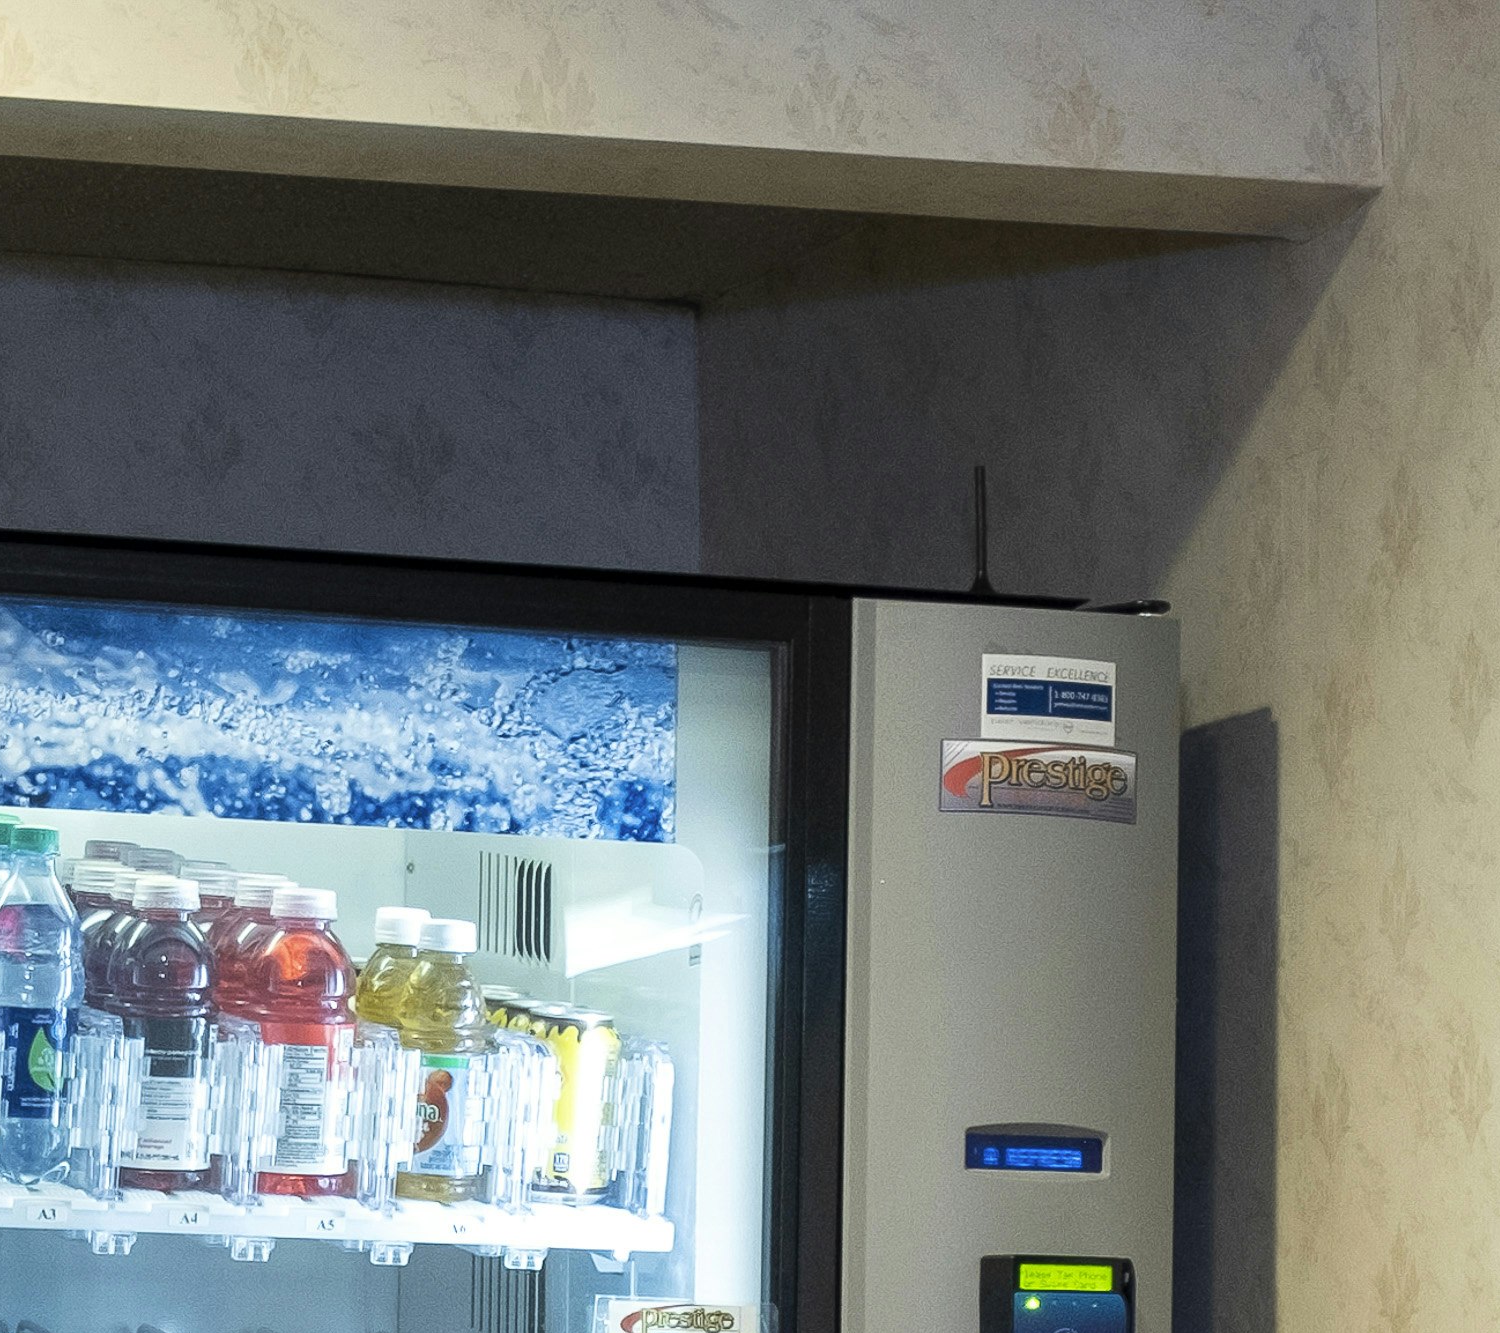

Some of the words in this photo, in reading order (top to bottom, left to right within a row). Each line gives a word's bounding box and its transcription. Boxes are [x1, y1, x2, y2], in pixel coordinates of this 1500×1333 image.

[989, 665, 1036, 678] SERVICE
[1047, 667, 1109, 682] EXCELLENCE
[36, 1208, 57, 1220] A3
[179, 1212, 198, 1225] A4
[316, 1218, 335, 1231] A5
